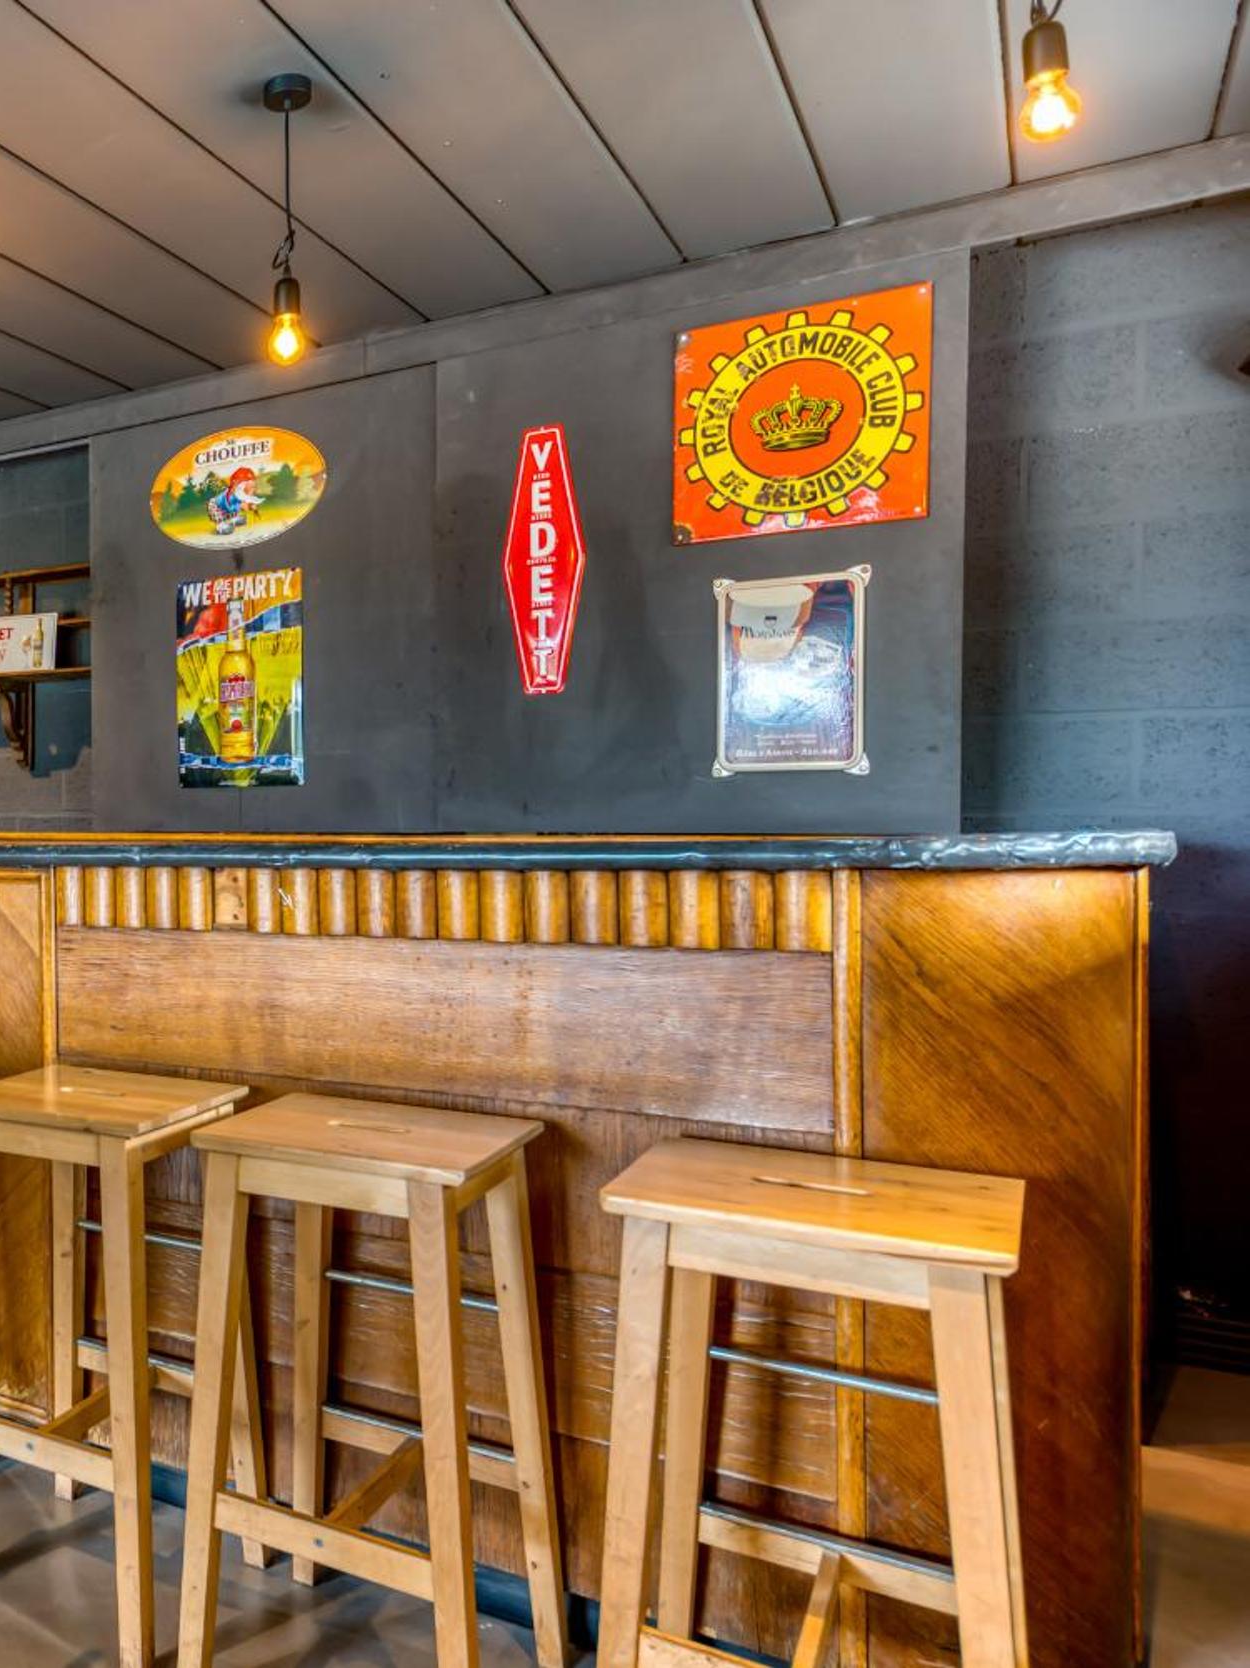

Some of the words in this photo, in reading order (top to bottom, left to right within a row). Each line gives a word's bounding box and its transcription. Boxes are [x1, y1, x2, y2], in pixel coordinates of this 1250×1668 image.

[700, 387, 739, 458] ROYAL
[735, 331, 879, 381] AUTOMOBILE
[866, 371, 898, 429] CLUB
[195, 440, 270, 465] CHOUFFE
[719, 470, 750, 498] DE
[754, 448, 876, 507] BELGIQUE
[529, 441, 557, 677] VEDETT
[183, 580, 212, 609] WE
[233, 571, 294, 601] PARTY
